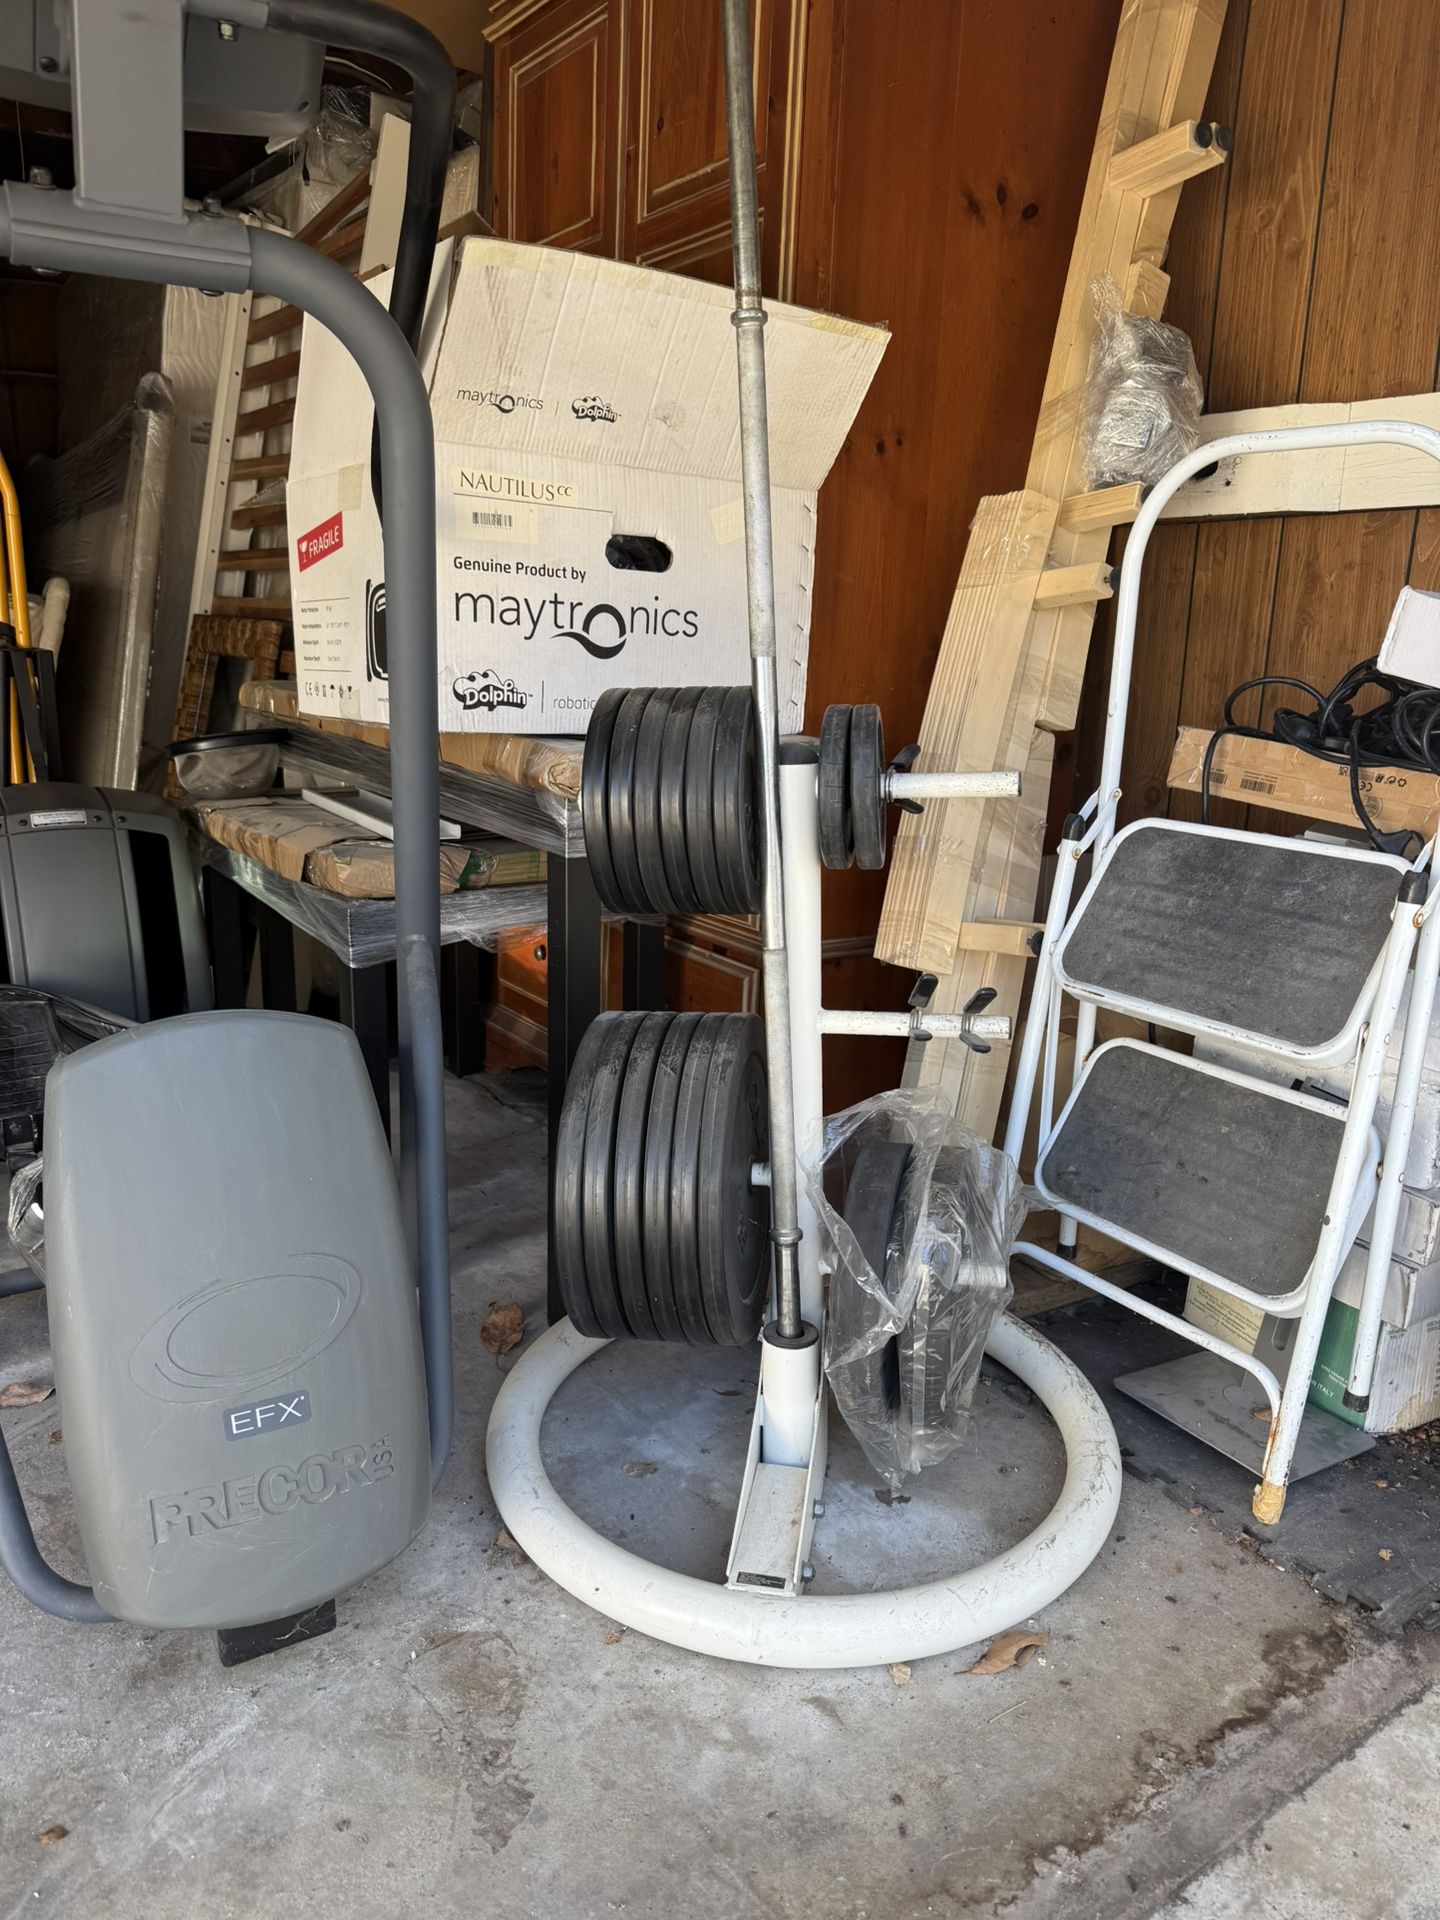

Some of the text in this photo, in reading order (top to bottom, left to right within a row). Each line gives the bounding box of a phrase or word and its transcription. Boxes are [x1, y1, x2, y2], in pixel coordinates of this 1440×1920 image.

[457, 389, 544, 413] maytronics
[575, 400, 617, 422] Dolphin
[460, 470, 555, 501] NAUTILUS
[309, 525, 340, 558] FRAGILE
[453, 556, 587, 583] Genuine Product by
[454, 591, 699, 659] maytronics
[459, 678, 528, 711] Dolphin
[230, 1396, 303, 1435] EFX
[150, 1444, 373, 1545] PRECOR
